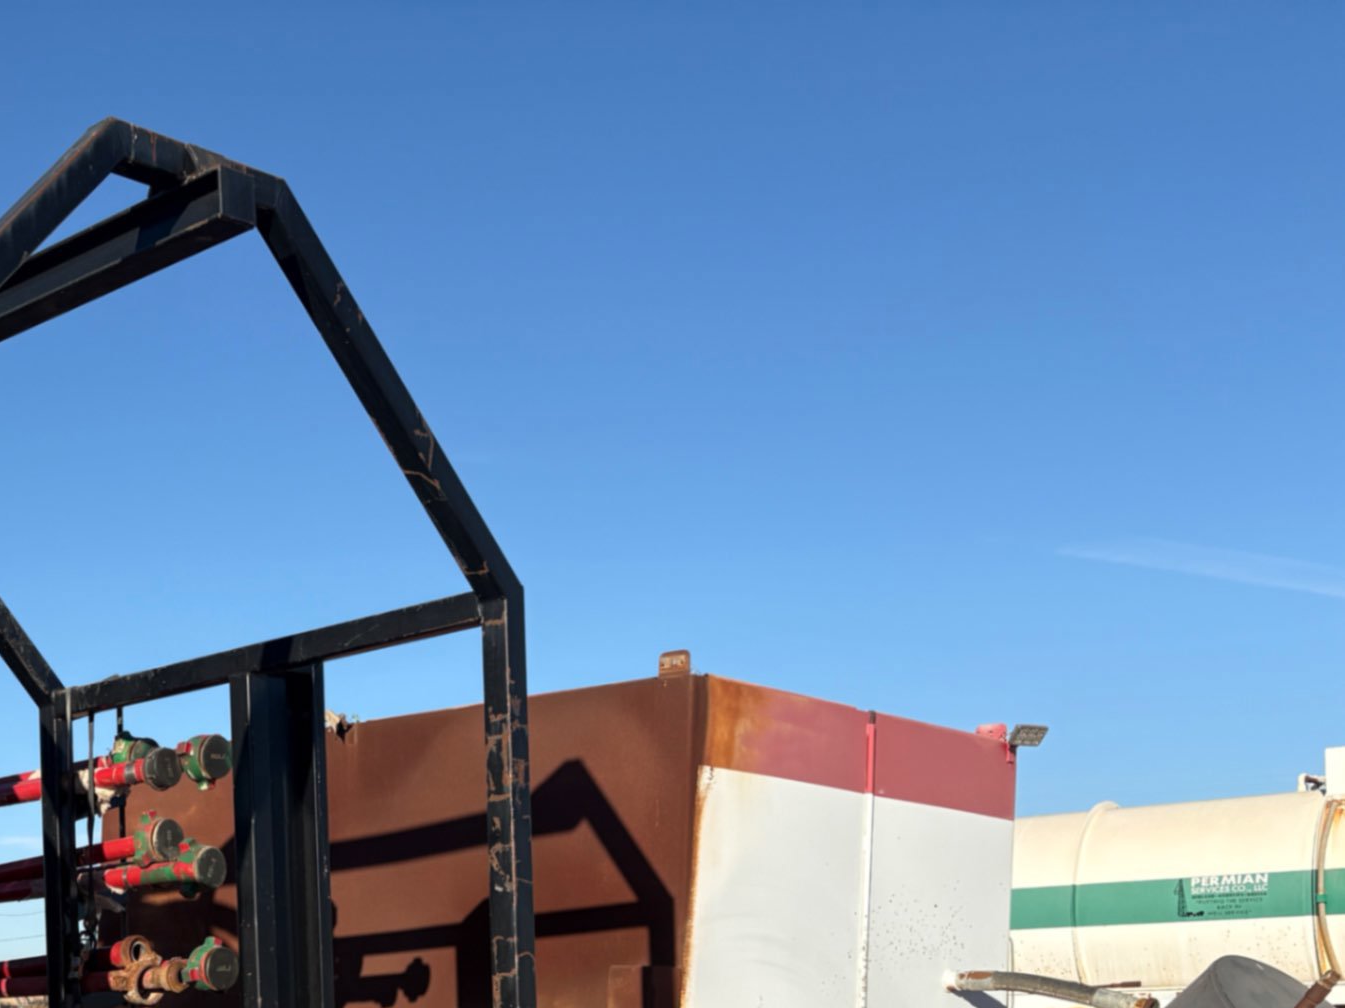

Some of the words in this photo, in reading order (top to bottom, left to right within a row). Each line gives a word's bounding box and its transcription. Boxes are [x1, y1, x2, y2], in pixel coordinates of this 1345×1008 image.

[1191, 873, 1269, 887] PERMIAN
[1191, 885, 1230, 895] SERVICES
[1254, 883, 1269, 892] LLC
